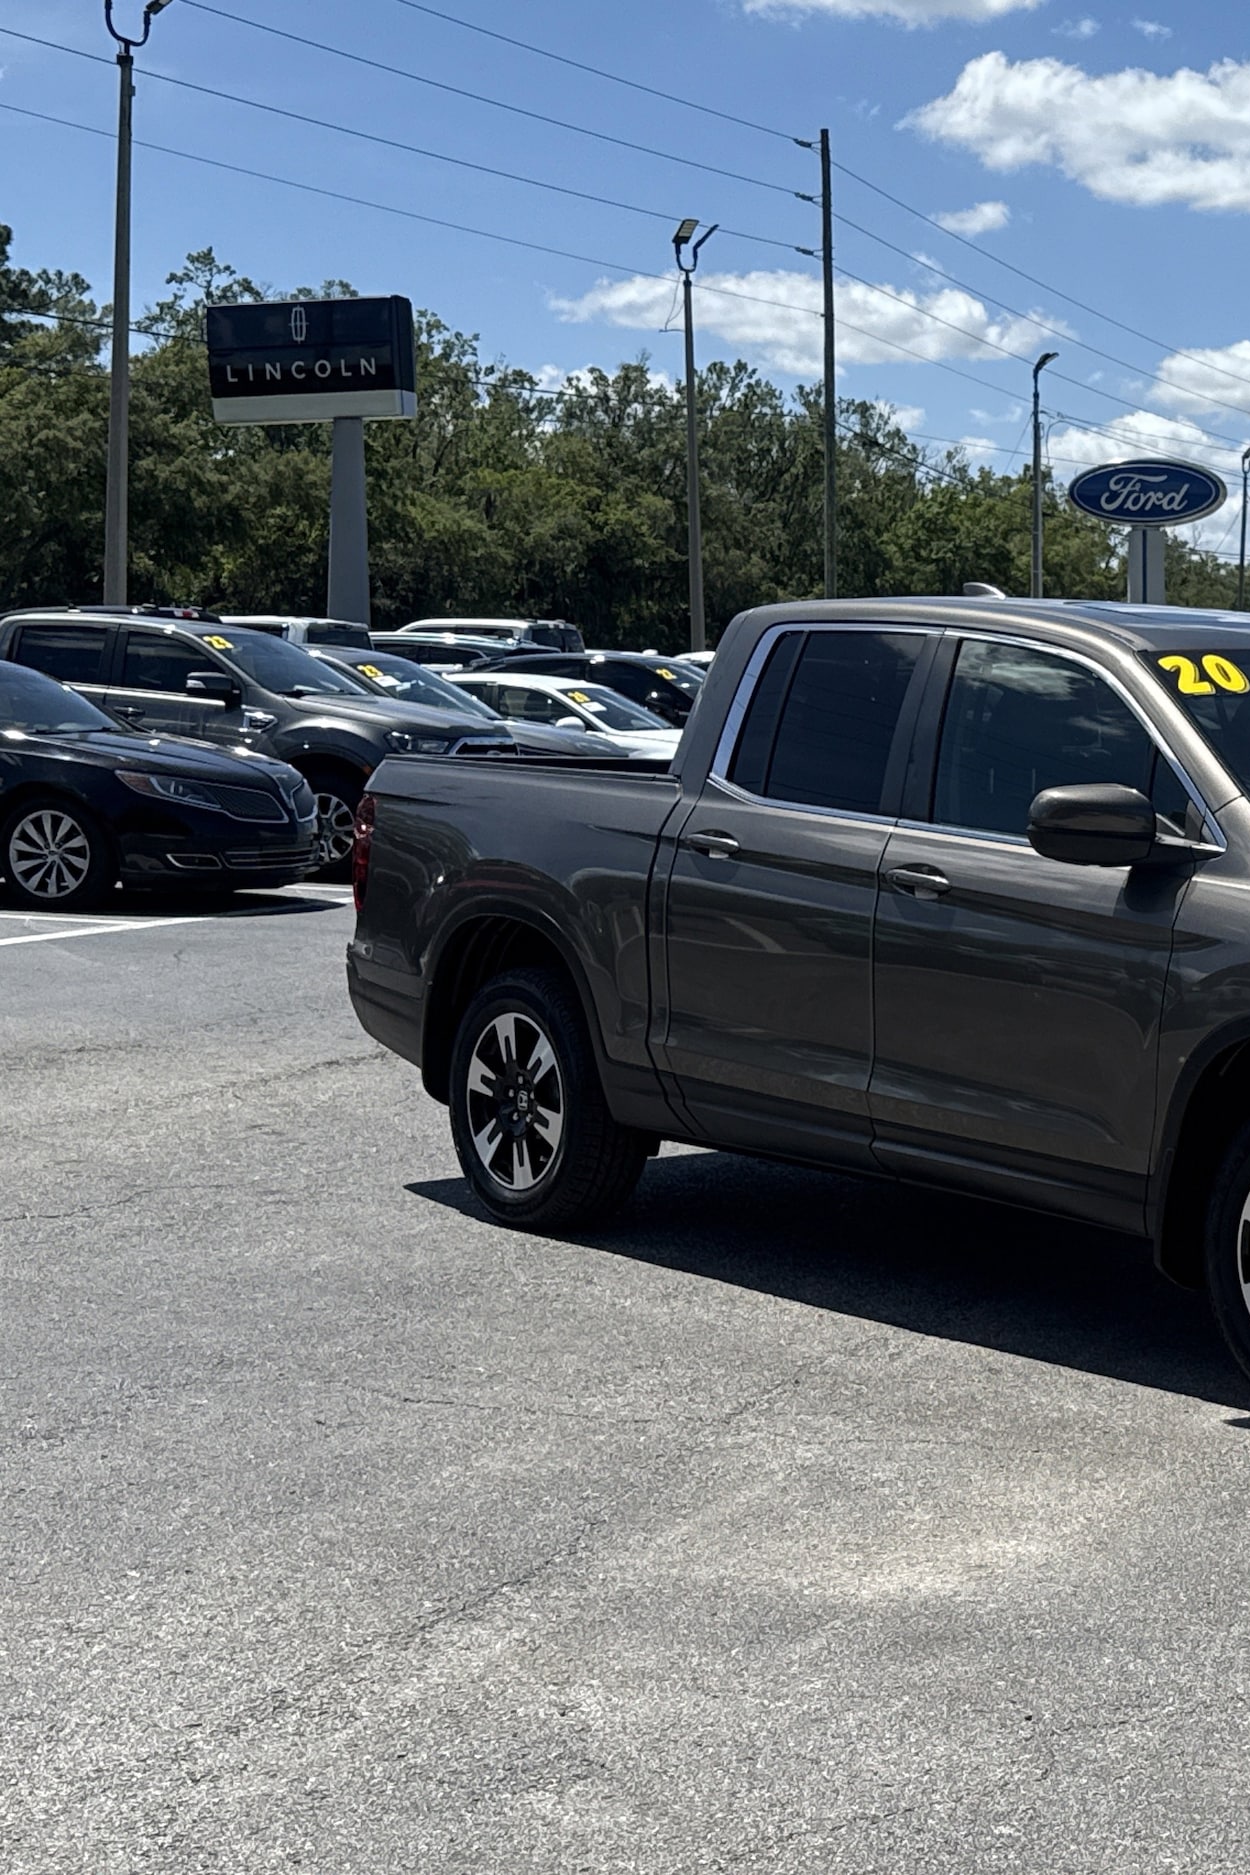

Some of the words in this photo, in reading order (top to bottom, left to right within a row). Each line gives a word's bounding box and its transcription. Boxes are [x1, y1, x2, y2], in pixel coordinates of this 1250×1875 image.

[226, 357, 377, 383] LINCOLN
[1100, 473, 1190, 512] Ford
[1157, 653, 1250, 695] 20
